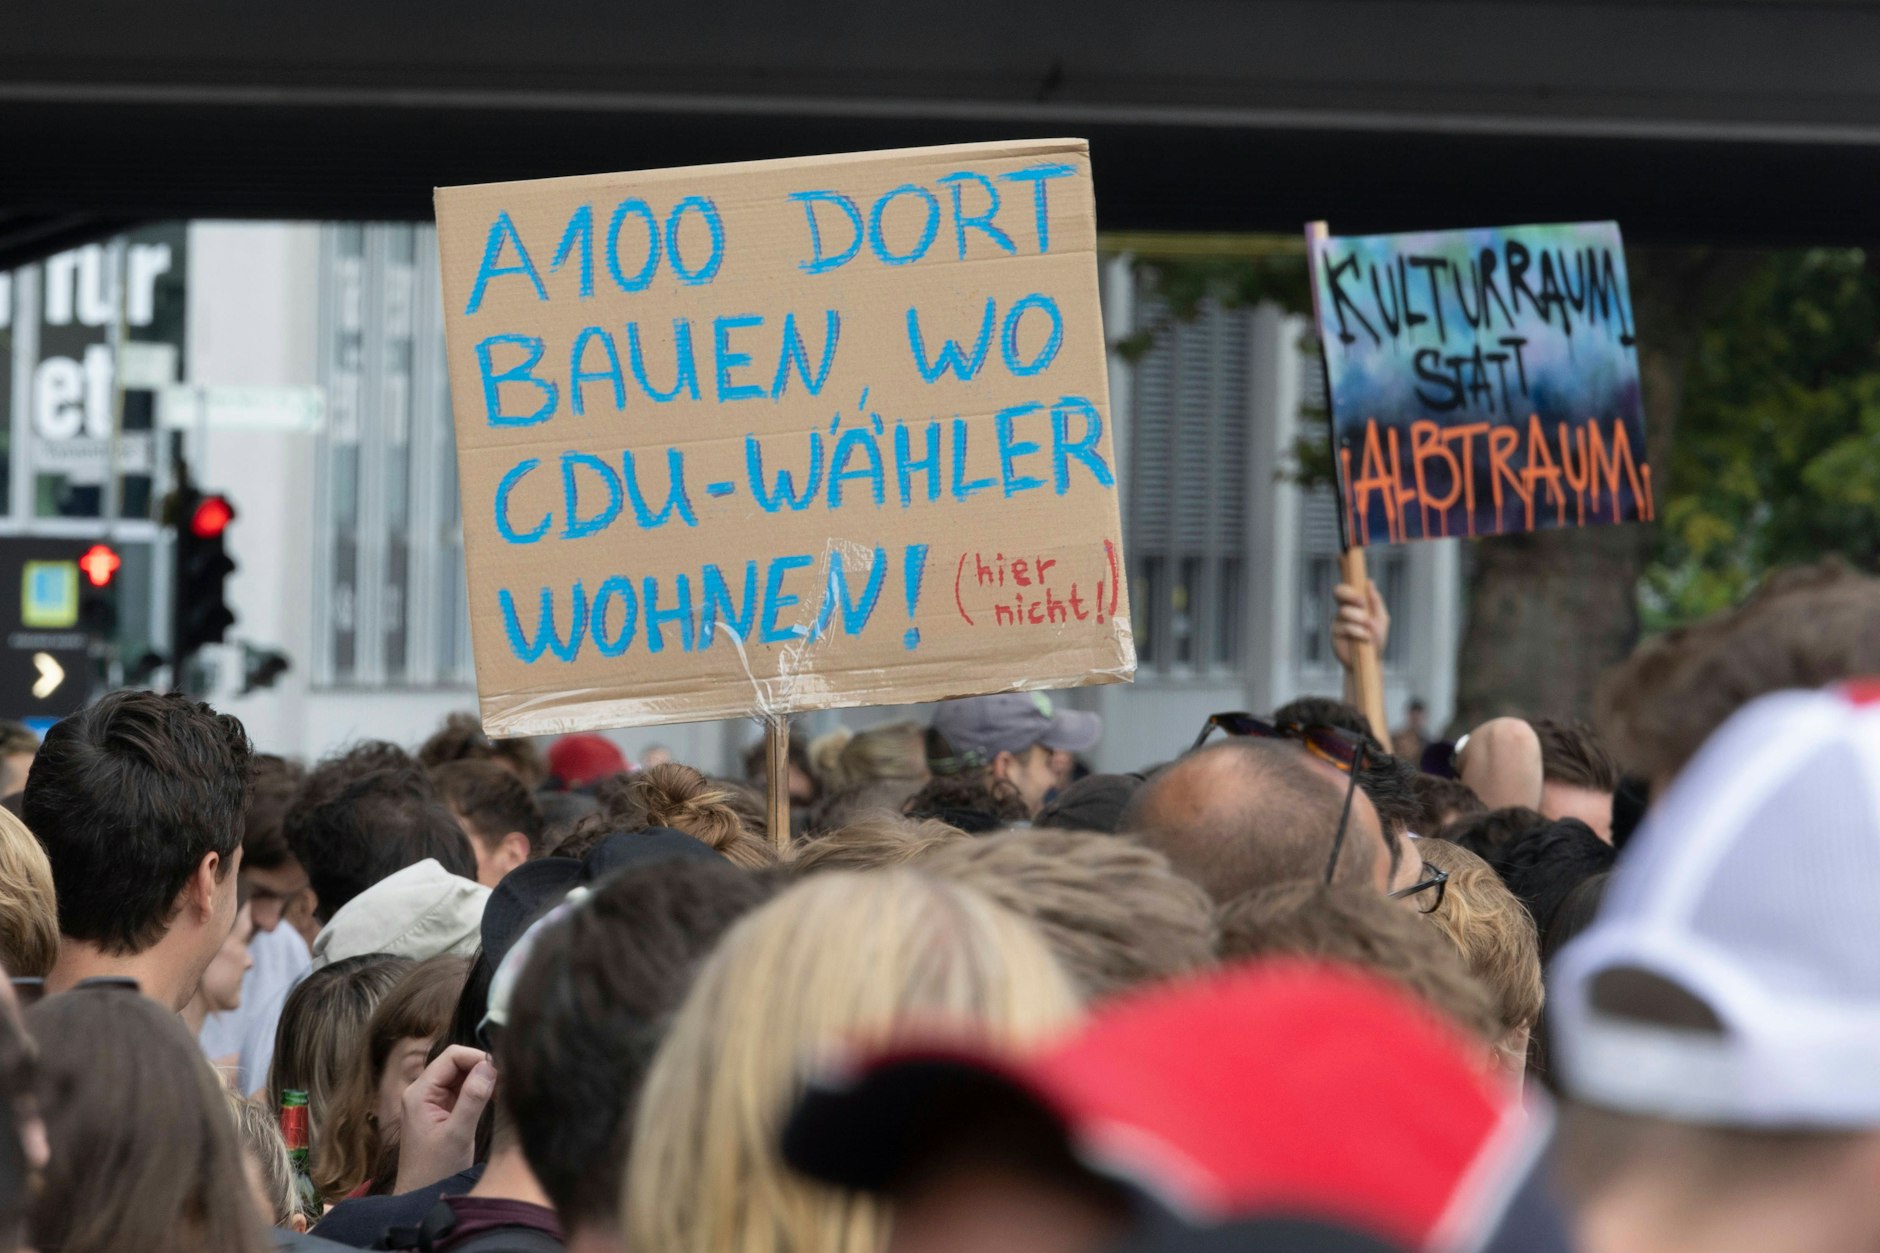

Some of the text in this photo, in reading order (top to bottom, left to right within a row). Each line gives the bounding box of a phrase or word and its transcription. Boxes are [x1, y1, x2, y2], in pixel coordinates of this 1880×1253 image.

[464, 163, 1078, 317] A100 DORT
[473, 293, 1064, 429] BAUEN, WO
[1411, 336, 1528, 414] STATT
[494, 395, 1116, 545] CDU-WÄHLER
[497, 543, 929, 665] WOHNEN!
